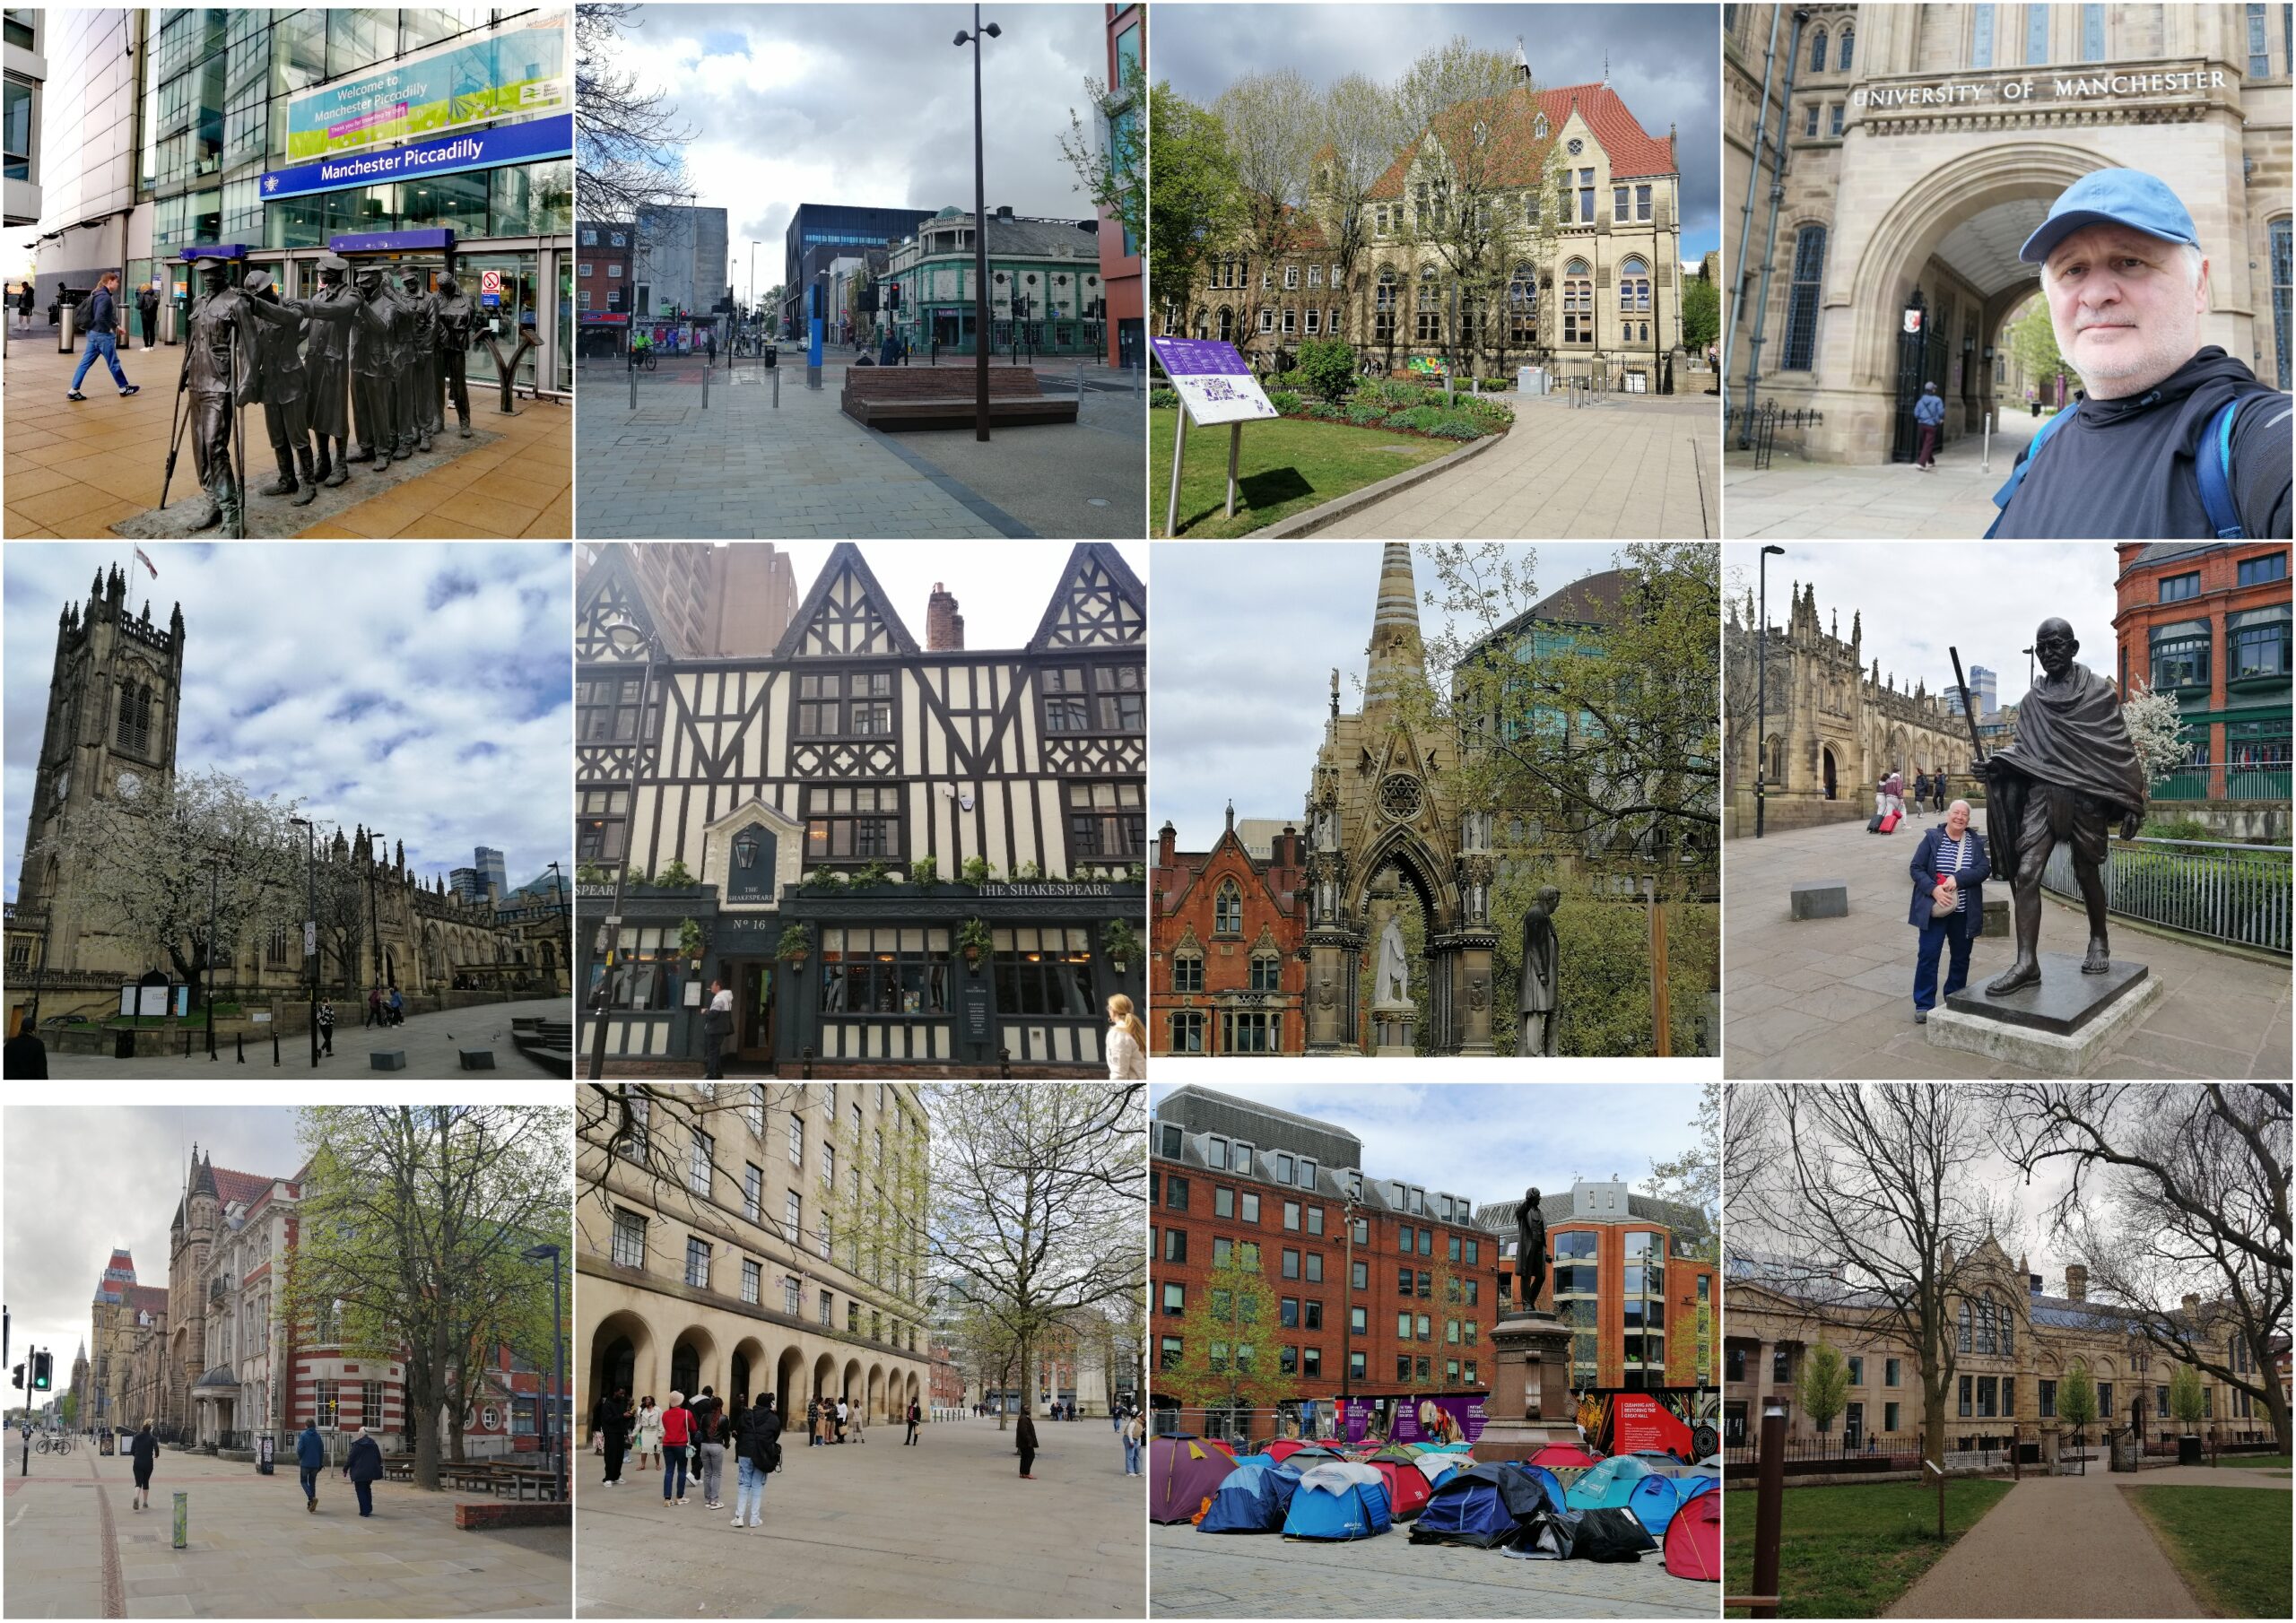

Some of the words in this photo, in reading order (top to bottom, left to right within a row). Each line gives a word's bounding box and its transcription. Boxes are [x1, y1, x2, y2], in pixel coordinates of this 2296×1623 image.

[337, 79, 384, 101] Welcome
[387, 75, 398, 87] to
[1853, 84, 1985, 106] UNIVERSITY
[2004, 82, 2033, 99] OF
[2056, 71, 2226, 96] MANCHESTER
[315, 99, 372, 123] Manchester
[374, 82, 428, 107] Piccadilly
[331, 125, 345, 134] Thank
[321, 155, 401, 181] Manchester
[404, 138, 484, 168] Piccadilly
[575, 884, 618, 897] SPEAR
[744, 886, 759, 894] THE
[978, 884, 1005, 897] THE
[1010, 884, 1112, 897] SHAKESPEARE
[727, 894, 773, 902] SHAKESPEARE
[752, 920, 766, 931] 16
